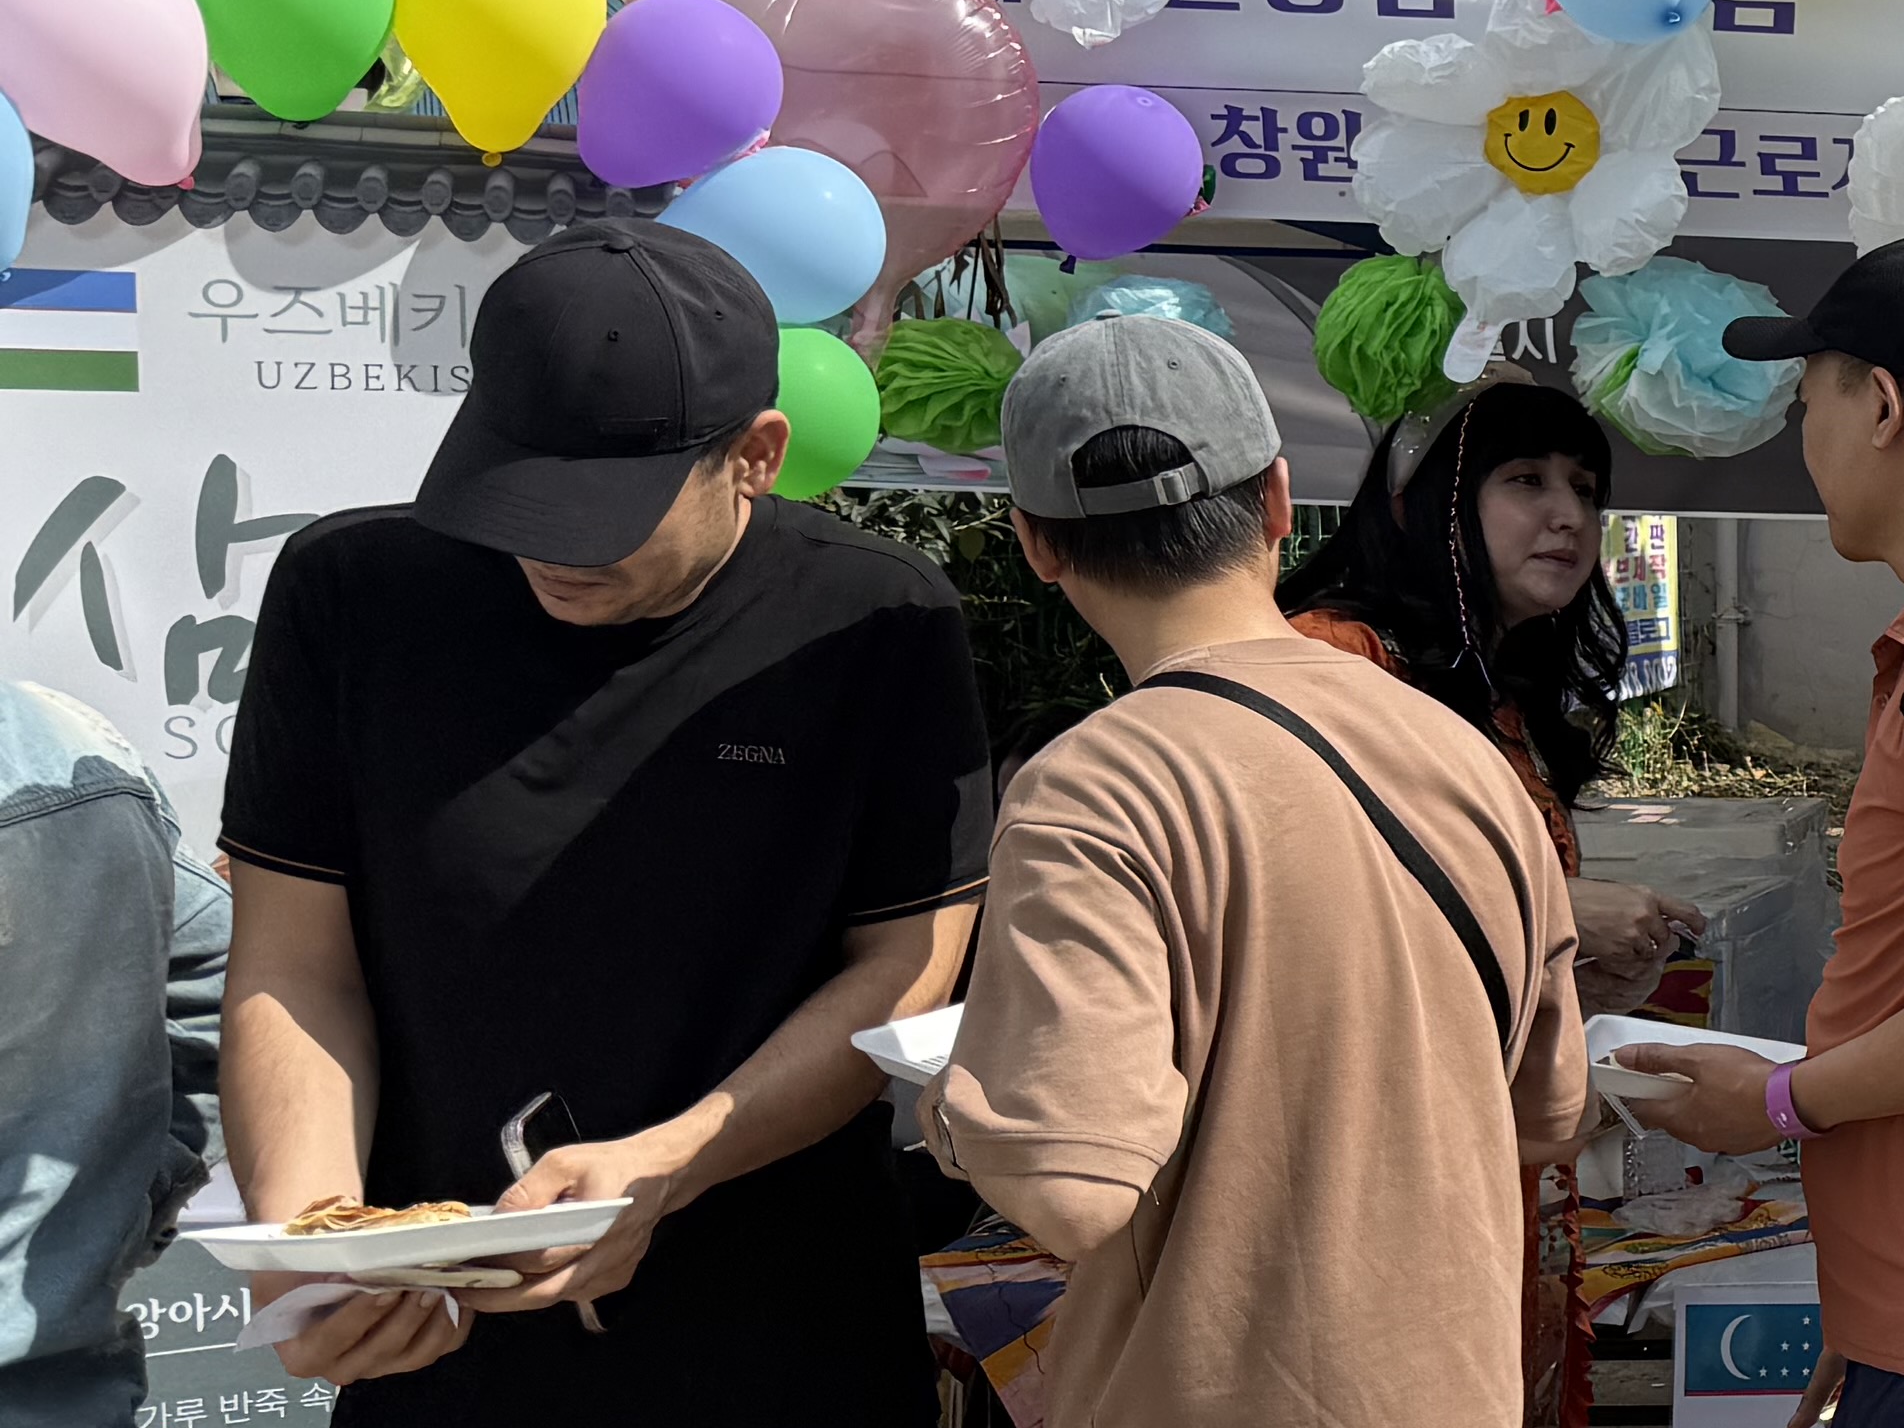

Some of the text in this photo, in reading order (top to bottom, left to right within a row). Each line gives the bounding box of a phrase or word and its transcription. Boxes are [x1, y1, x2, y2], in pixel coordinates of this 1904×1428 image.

[1208, 103, 1850, 201] 창원 근로
[187, 278, 470, 348] 우즈베키
[254, 360, 471, 394] UZBEKIS
[717, 743, 786, 765] ZEGNA
[219, 1387, 289, 1425] 반죽
